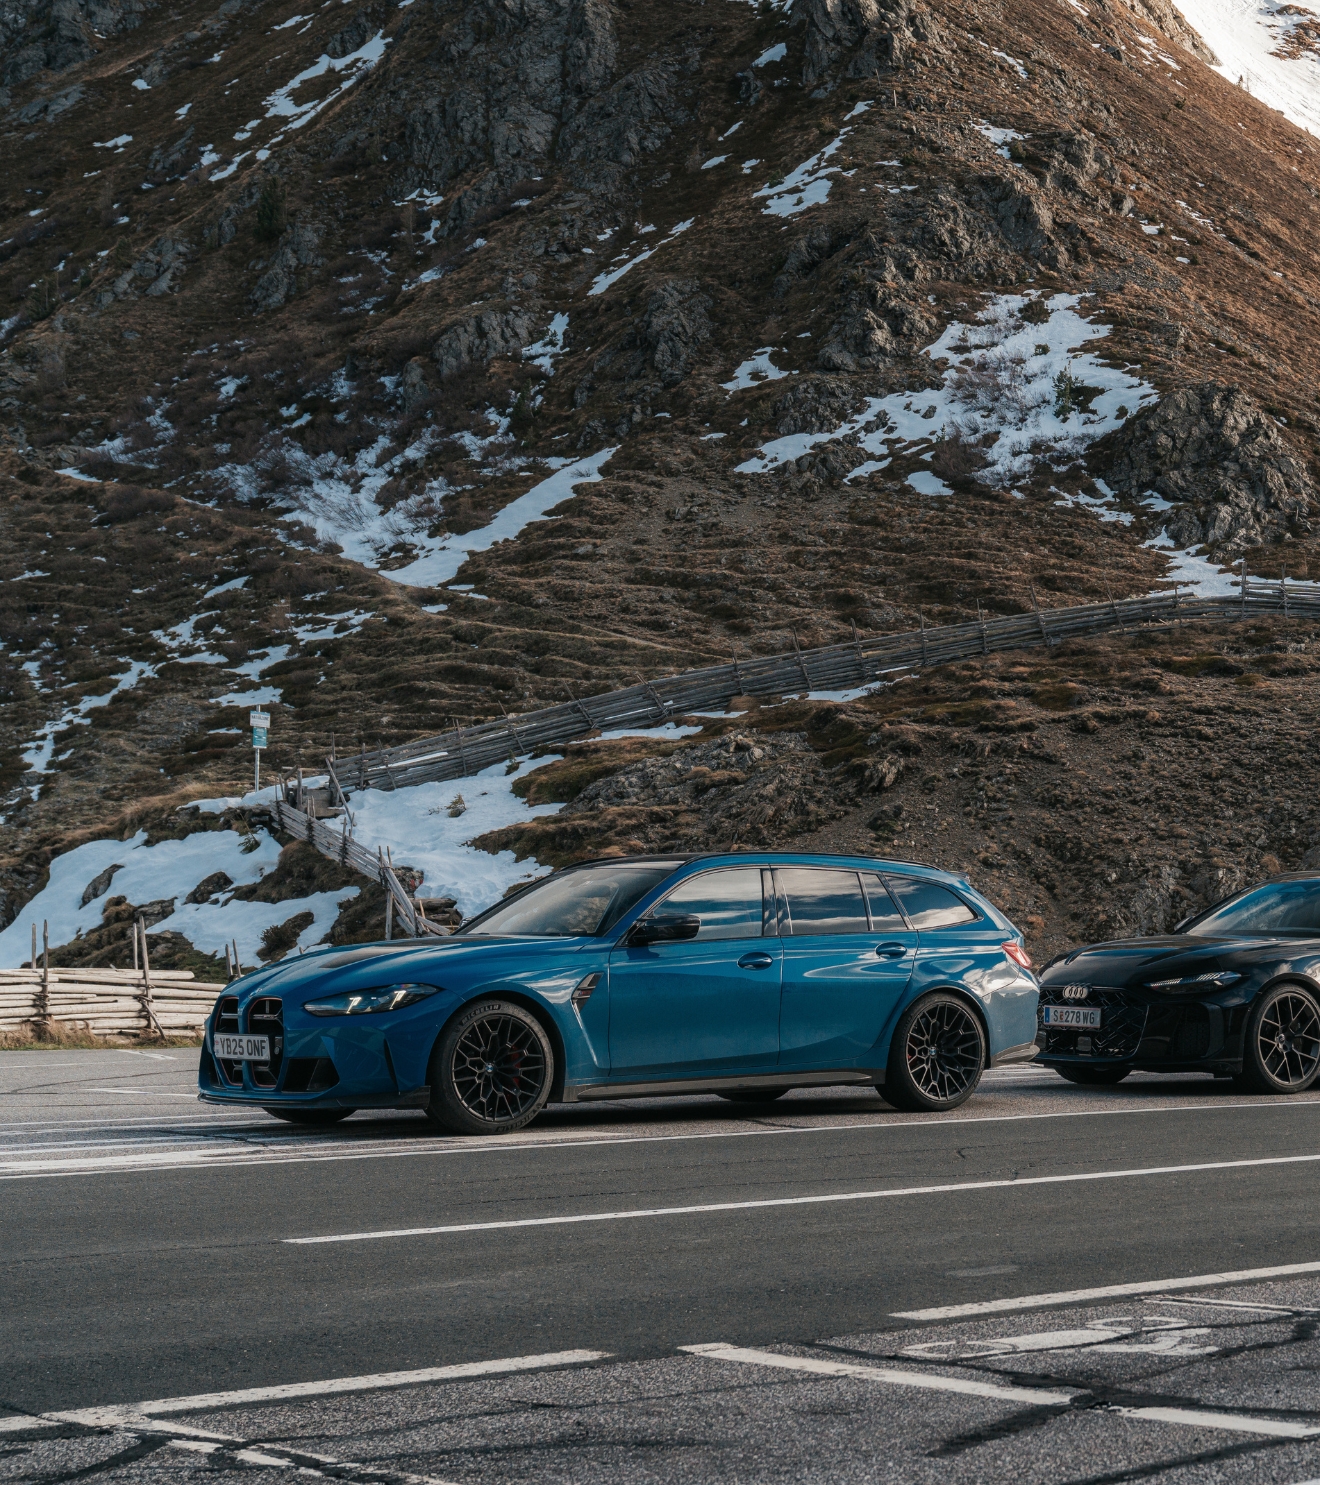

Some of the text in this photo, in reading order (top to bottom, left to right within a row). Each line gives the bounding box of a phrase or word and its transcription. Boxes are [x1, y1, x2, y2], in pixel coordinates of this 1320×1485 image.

[1053, 1009, 1095, 1024] S 278 WG
[220, 1037, 266, 1057] YB25 ONF
